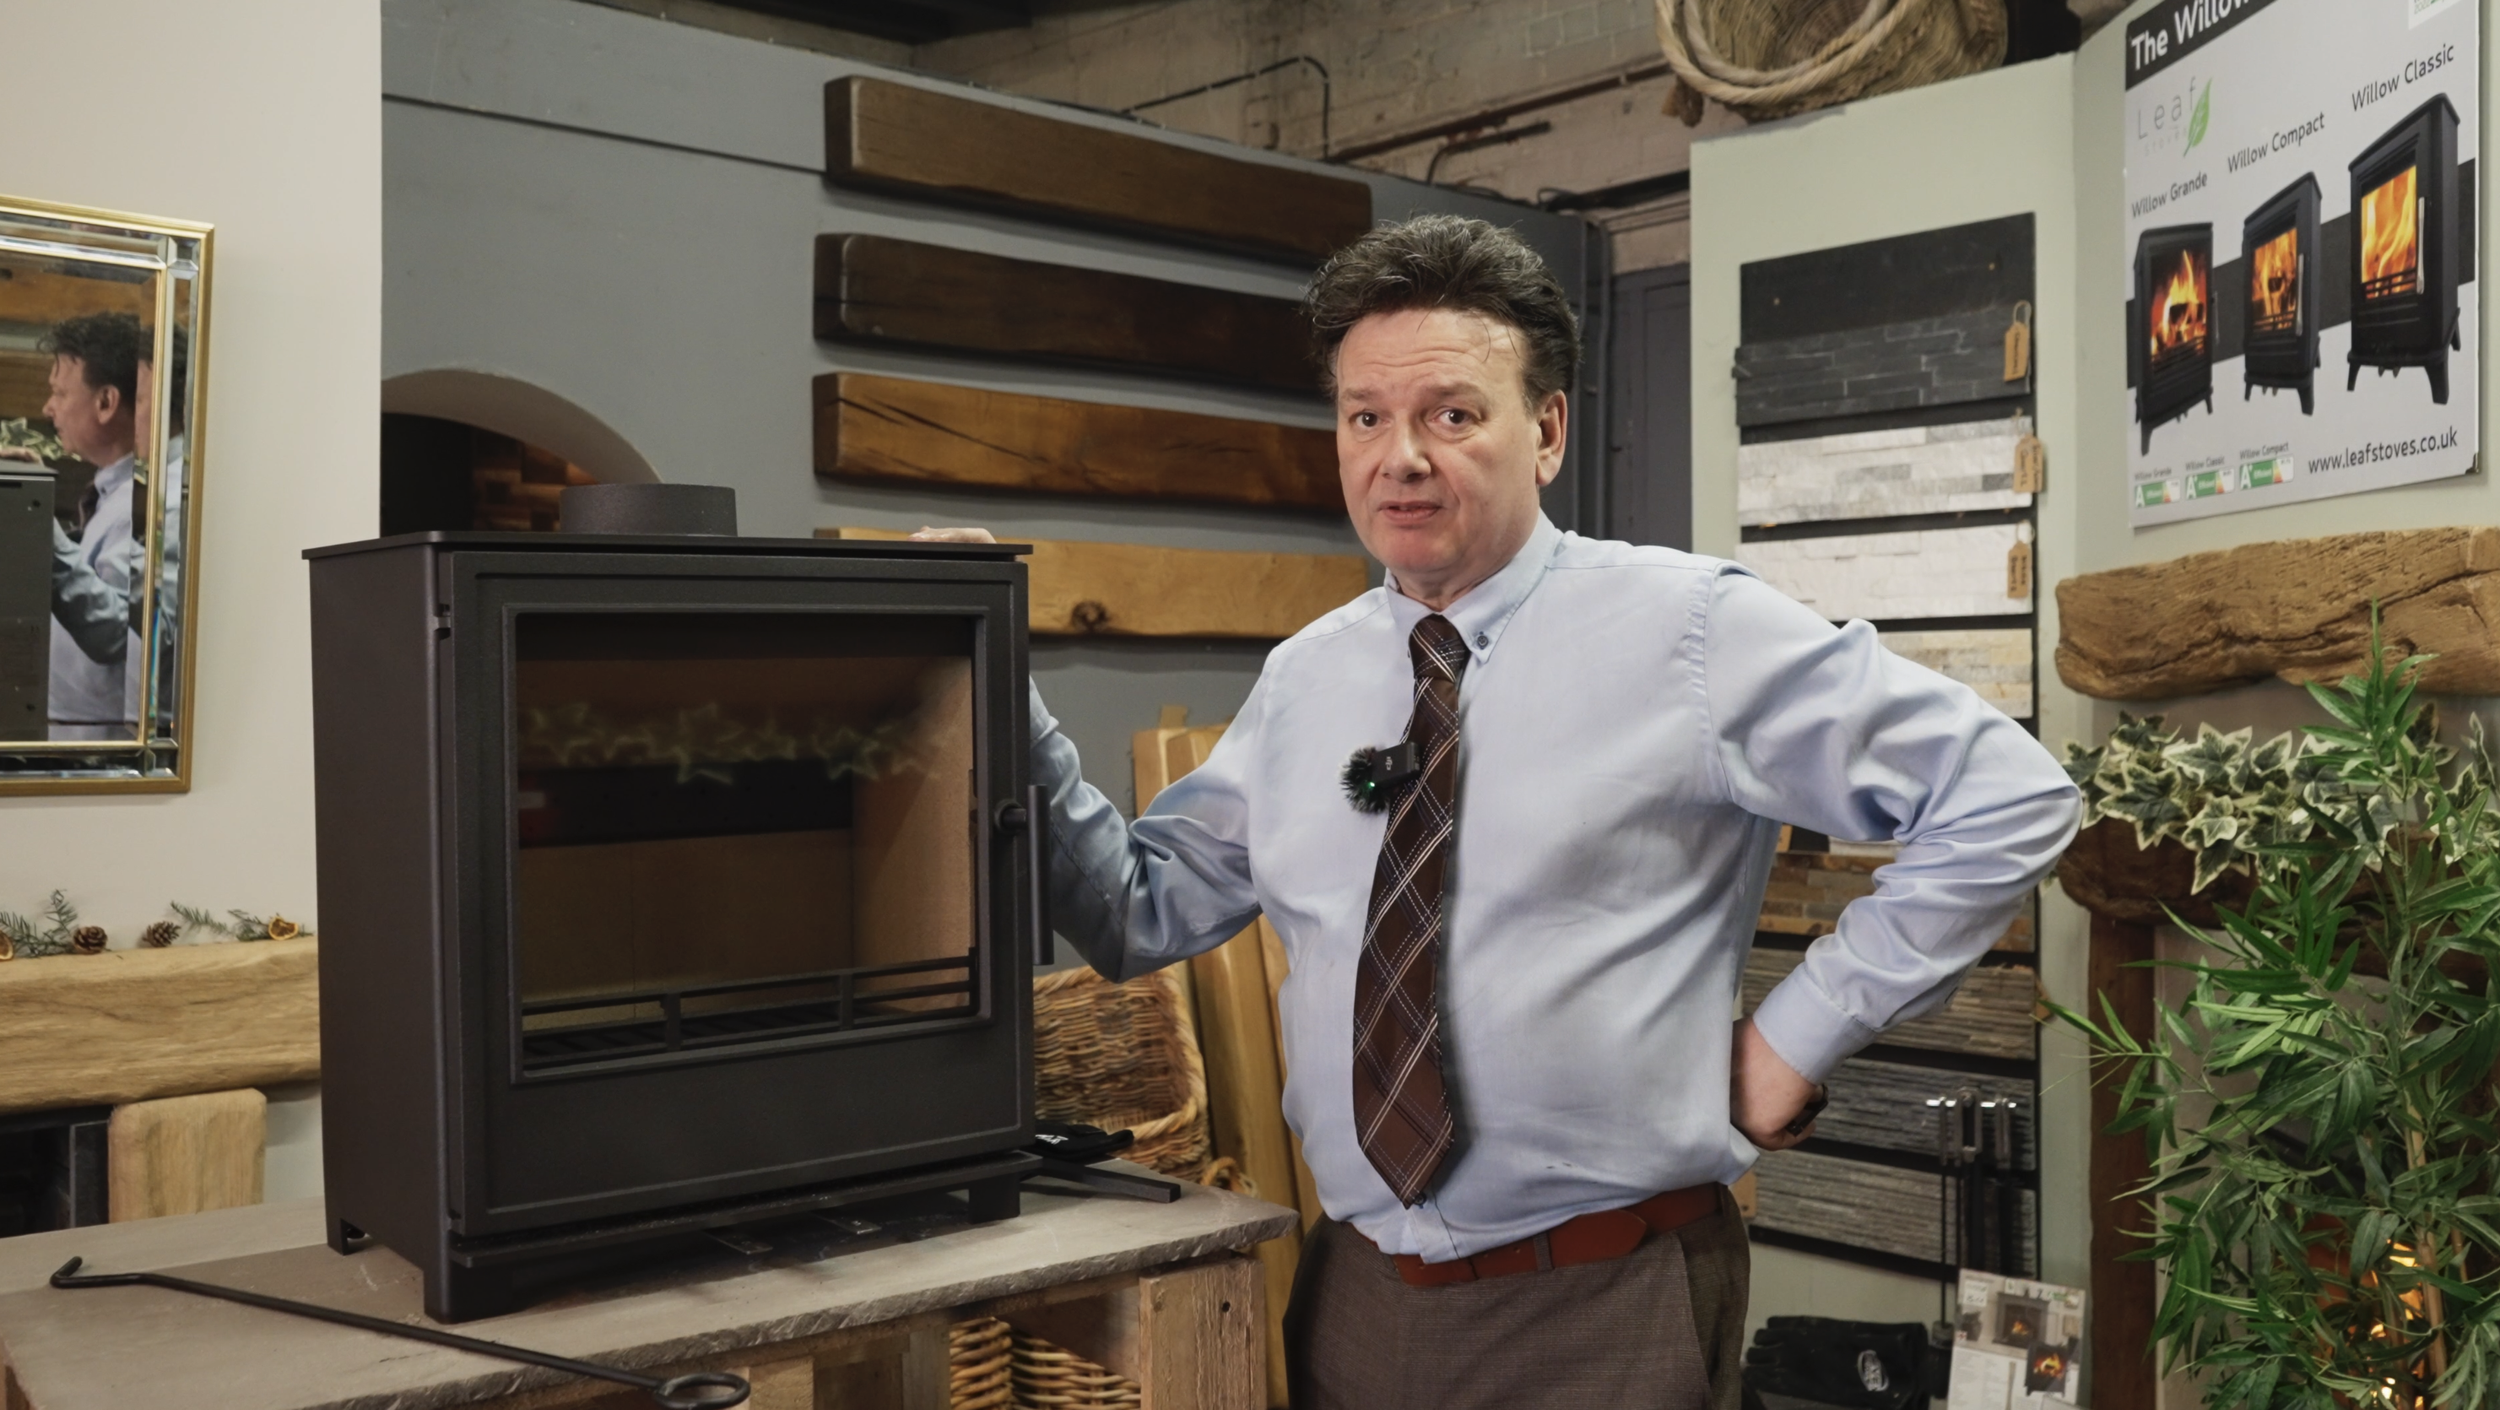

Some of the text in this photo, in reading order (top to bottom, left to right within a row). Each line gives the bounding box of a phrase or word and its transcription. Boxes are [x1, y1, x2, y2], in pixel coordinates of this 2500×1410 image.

[2131, 29, 2168, 70] The
[2352, 43, 2454, 112] Willow Classic
[2138, 76, 2196, 140] Leaf
[2227, 111, 2325, 174] Willow Compact
[2131, 170, 2208, 218] Willow Grande
[2308, 425, 2458, 474] www.leafstoves.co.uk
